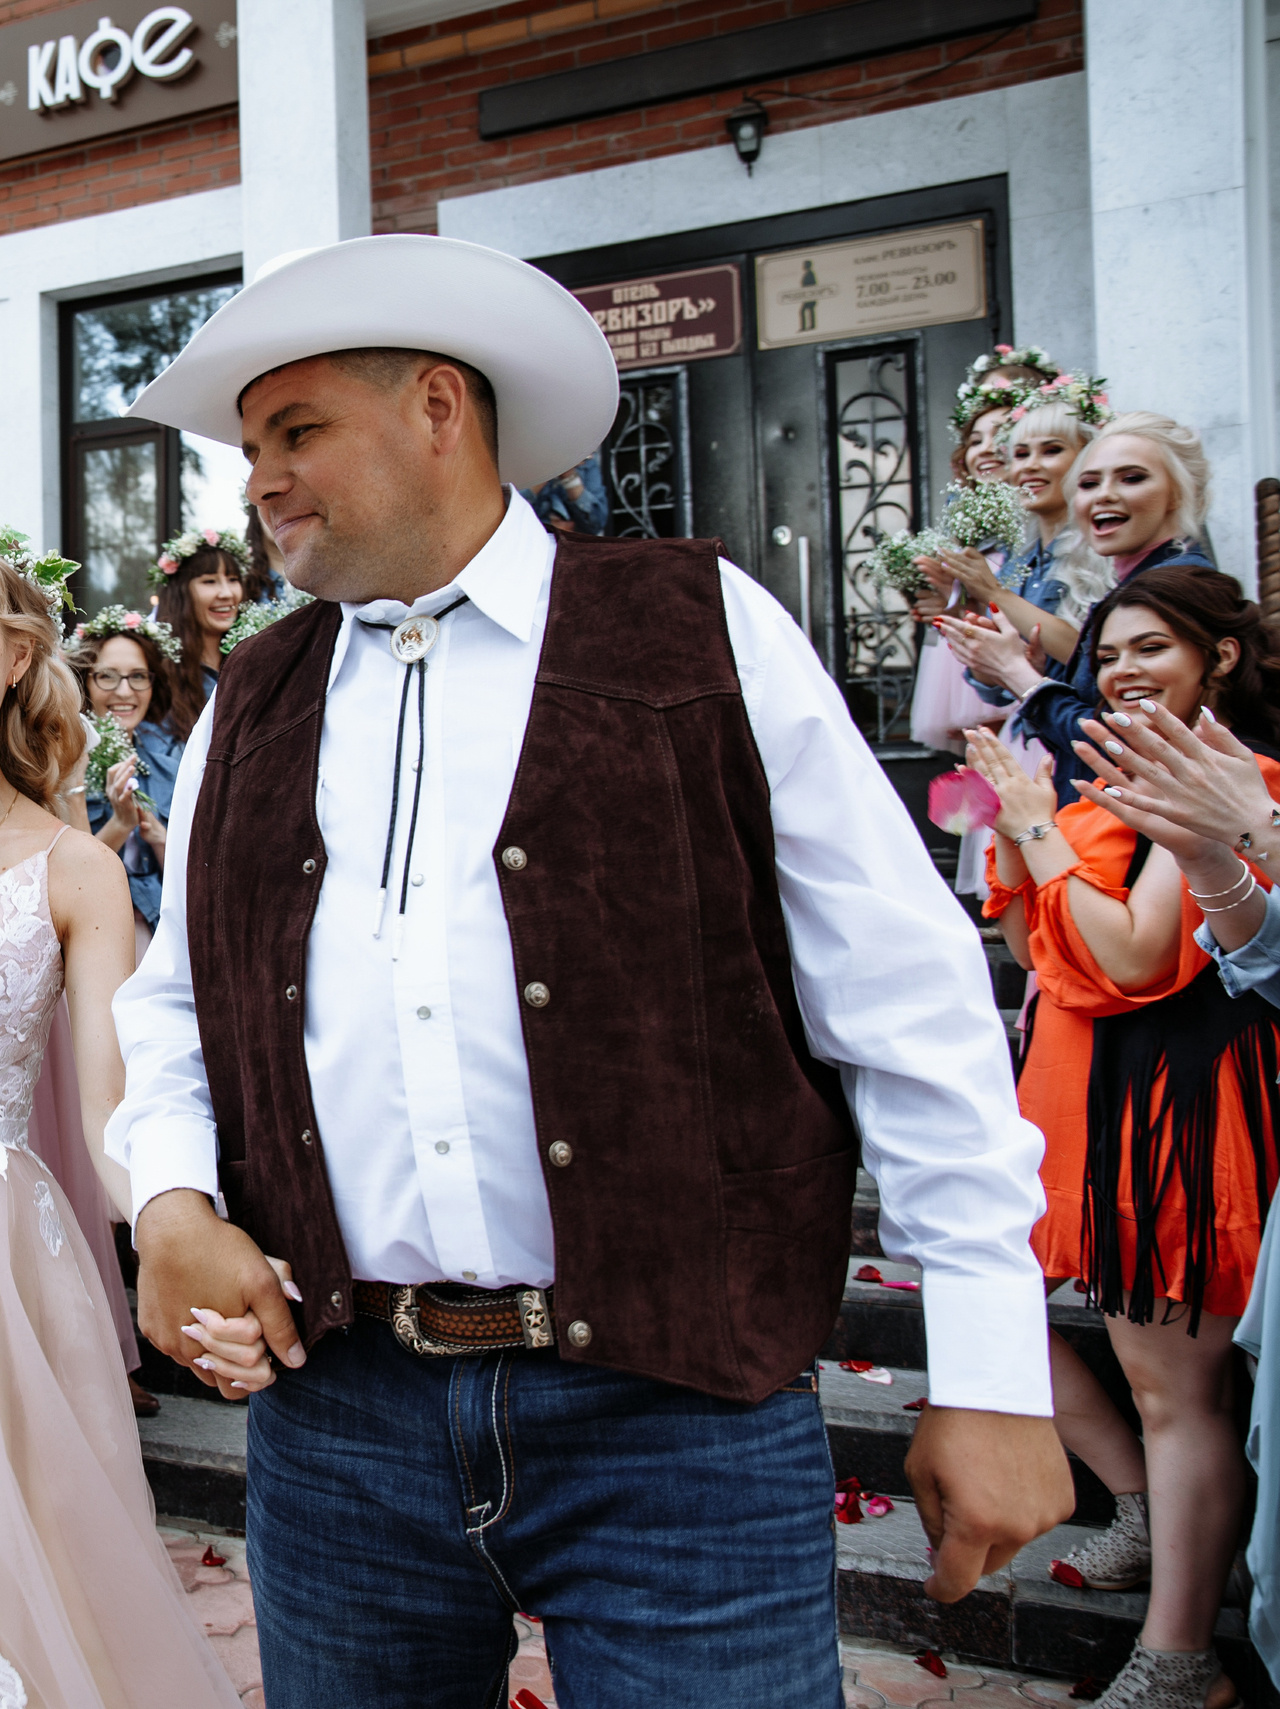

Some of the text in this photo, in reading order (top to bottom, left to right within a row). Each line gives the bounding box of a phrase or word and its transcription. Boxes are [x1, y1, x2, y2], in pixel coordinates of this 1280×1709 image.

[612, 283, 661, 304] ОТЕЛЬ
[856, 281, 890, 299] 7.00
[912, 270, 958, 291] 23.00
